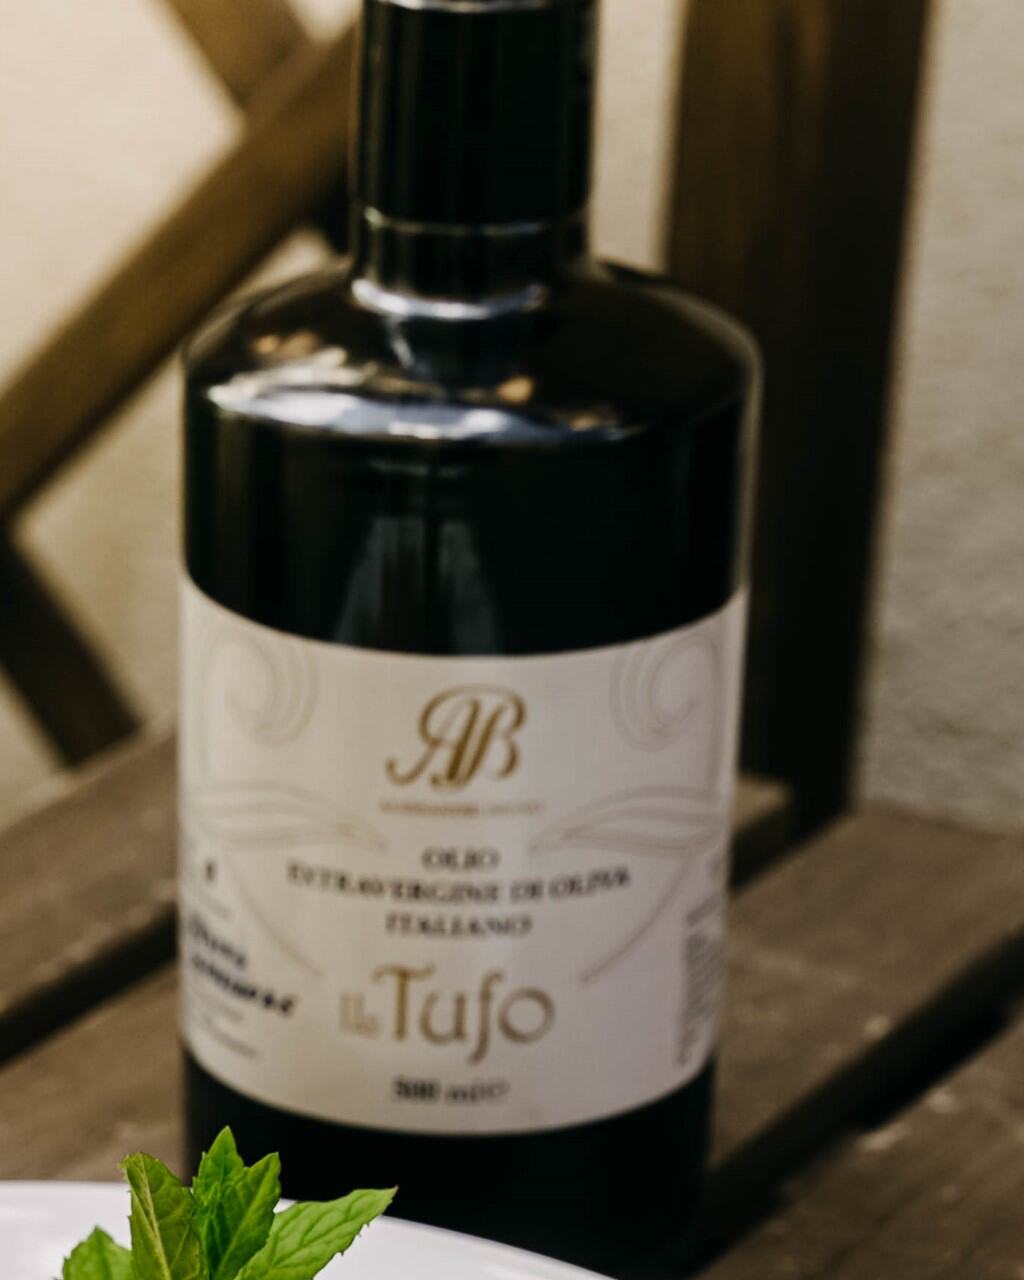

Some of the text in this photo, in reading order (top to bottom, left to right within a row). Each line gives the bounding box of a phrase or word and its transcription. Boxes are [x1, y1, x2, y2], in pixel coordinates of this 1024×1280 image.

[422, 848, 499, 870] OLIO
[385, 912, 532, 937] ITALIANO
[373, 964, 556, 1066] Tufo
